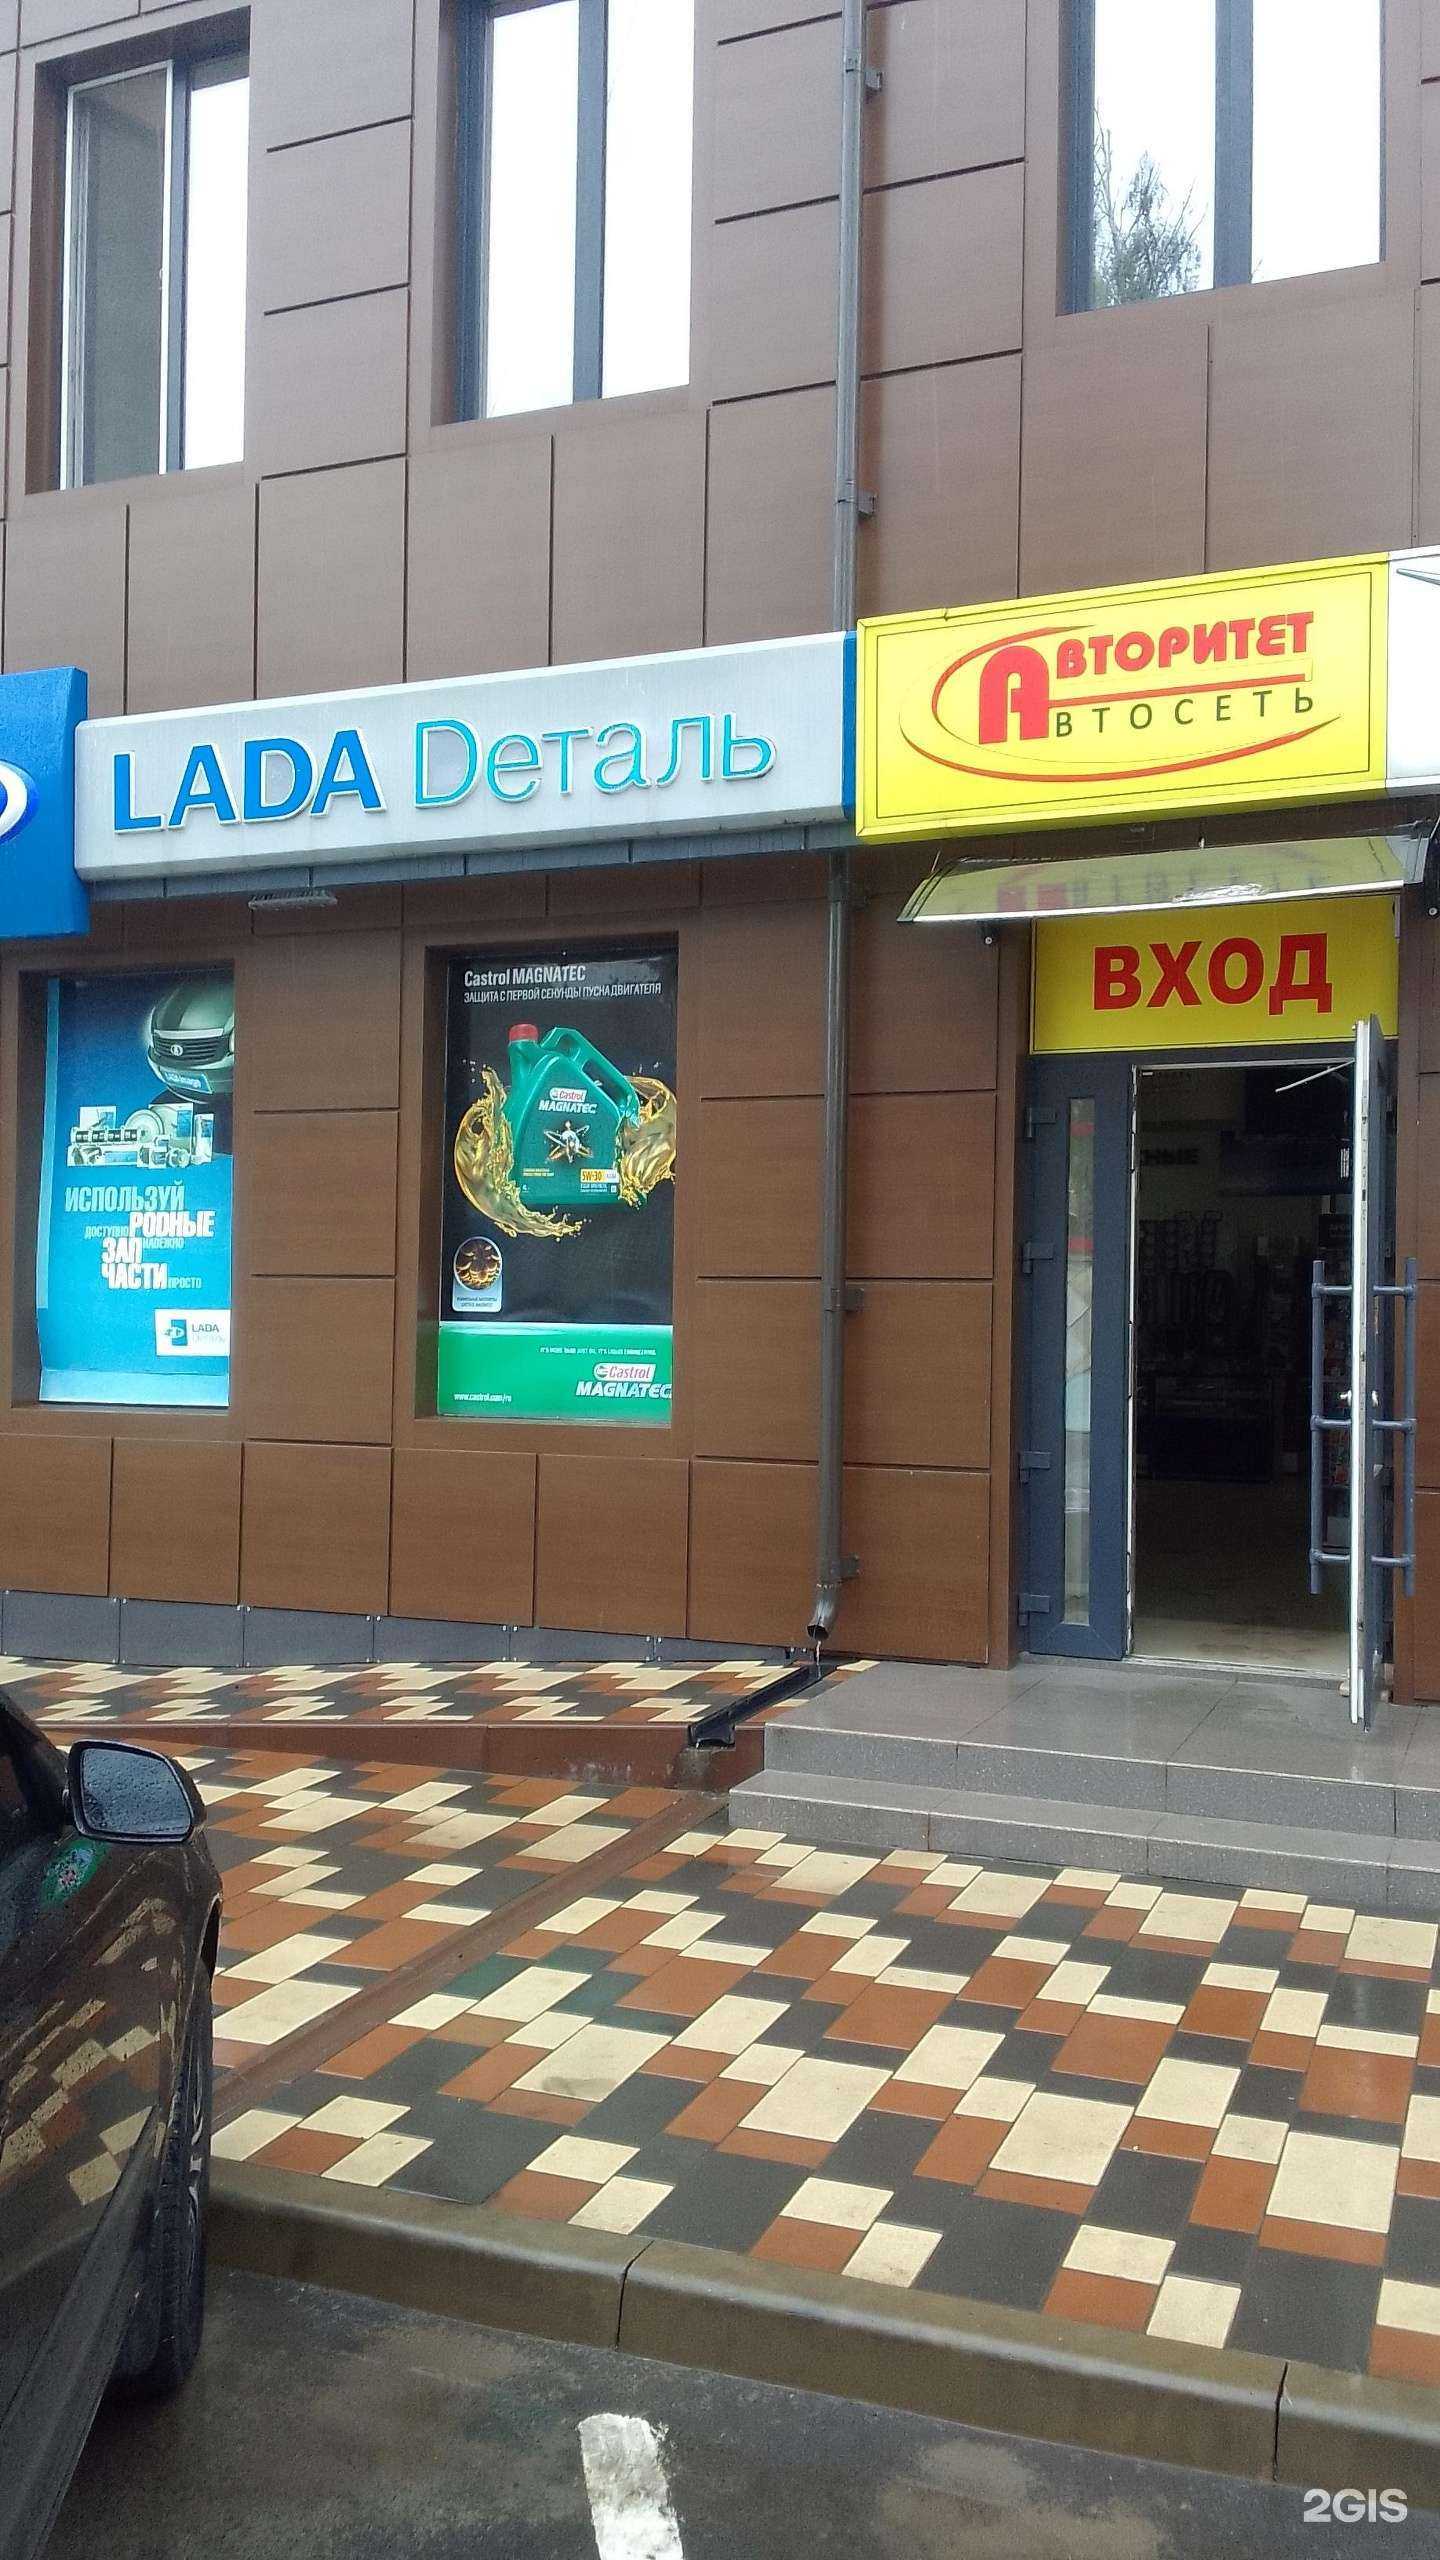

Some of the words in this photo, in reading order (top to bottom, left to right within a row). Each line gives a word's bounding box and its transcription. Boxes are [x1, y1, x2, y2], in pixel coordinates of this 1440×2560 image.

[114, 729, 386, 834] LADA
[464, 968, 510, 987] Castrol
[512, 965, 586, 985] MAGNATEC
[1092, 933, 1333, 1015] ВХОД
[464, 990, 499, 1003] ЗАЩИТА
[499, 990, 506, 1001] С
[506, 987, 540, 1001] ПЕРВОЙ
[610, 982, 662, 998] ДВИГАТЕЛЯ
[559, 1089, 584, 1101] Castrol
[539, 1100, 597, 1114] MAGNATEC
[582, 1170, 603, 1181] 5W-30
[65, 1180, 185, 1212] ИСПОЛЬЗУЙ
[129, 1210, 215, 1237] РОДНЫЕ
[102, 1237, 143, 1263] ЗАП
[101, 1262, 168, 1289] ЧАСТИ
[168, 1276, 202, 1288] ПРОСТО
[192, 1324, 219, 1332] LADA
[609, 1365, 651, 1379] Castrol
[576, 1381, 673, 1398] MAGNATEC
